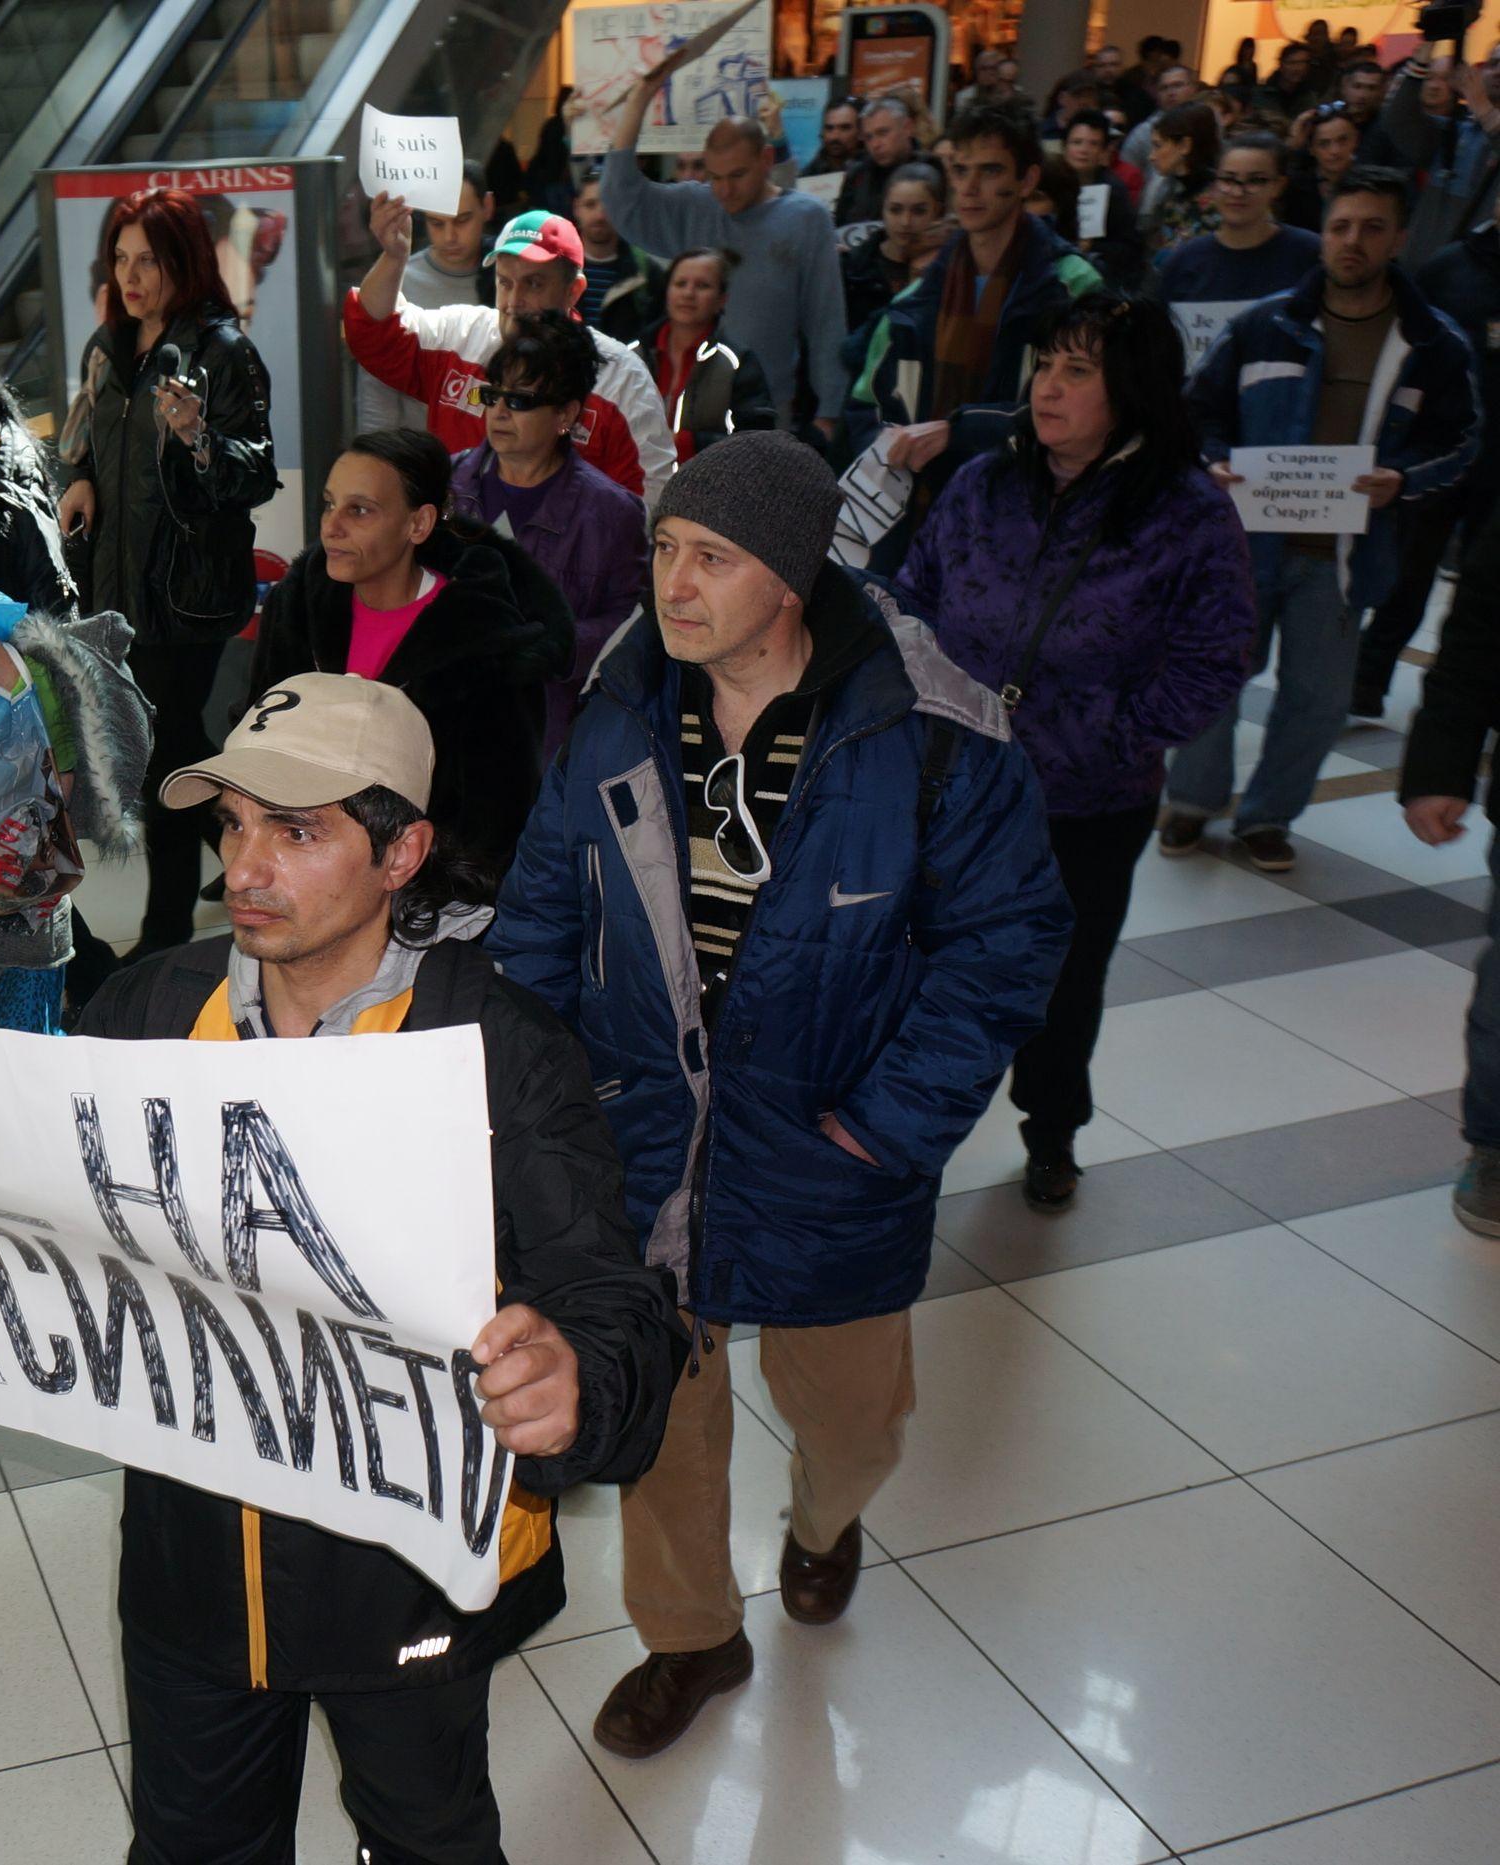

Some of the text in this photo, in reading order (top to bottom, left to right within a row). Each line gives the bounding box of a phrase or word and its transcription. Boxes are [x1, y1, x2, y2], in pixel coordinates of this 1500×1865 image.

[371, 126, 438, 152] Je suis
[148, 165, 293, 190] CLARINS
[375, 158, 438, 181] Нягол
[1266, 452, 1338, 466] Старите
[1318, 471, 1337, 481] те
[1252, 486, 1345, 501] обричат на
[1262, 505, 1318, 522] Смърт
[70, 1091, 392, 1322] НА
